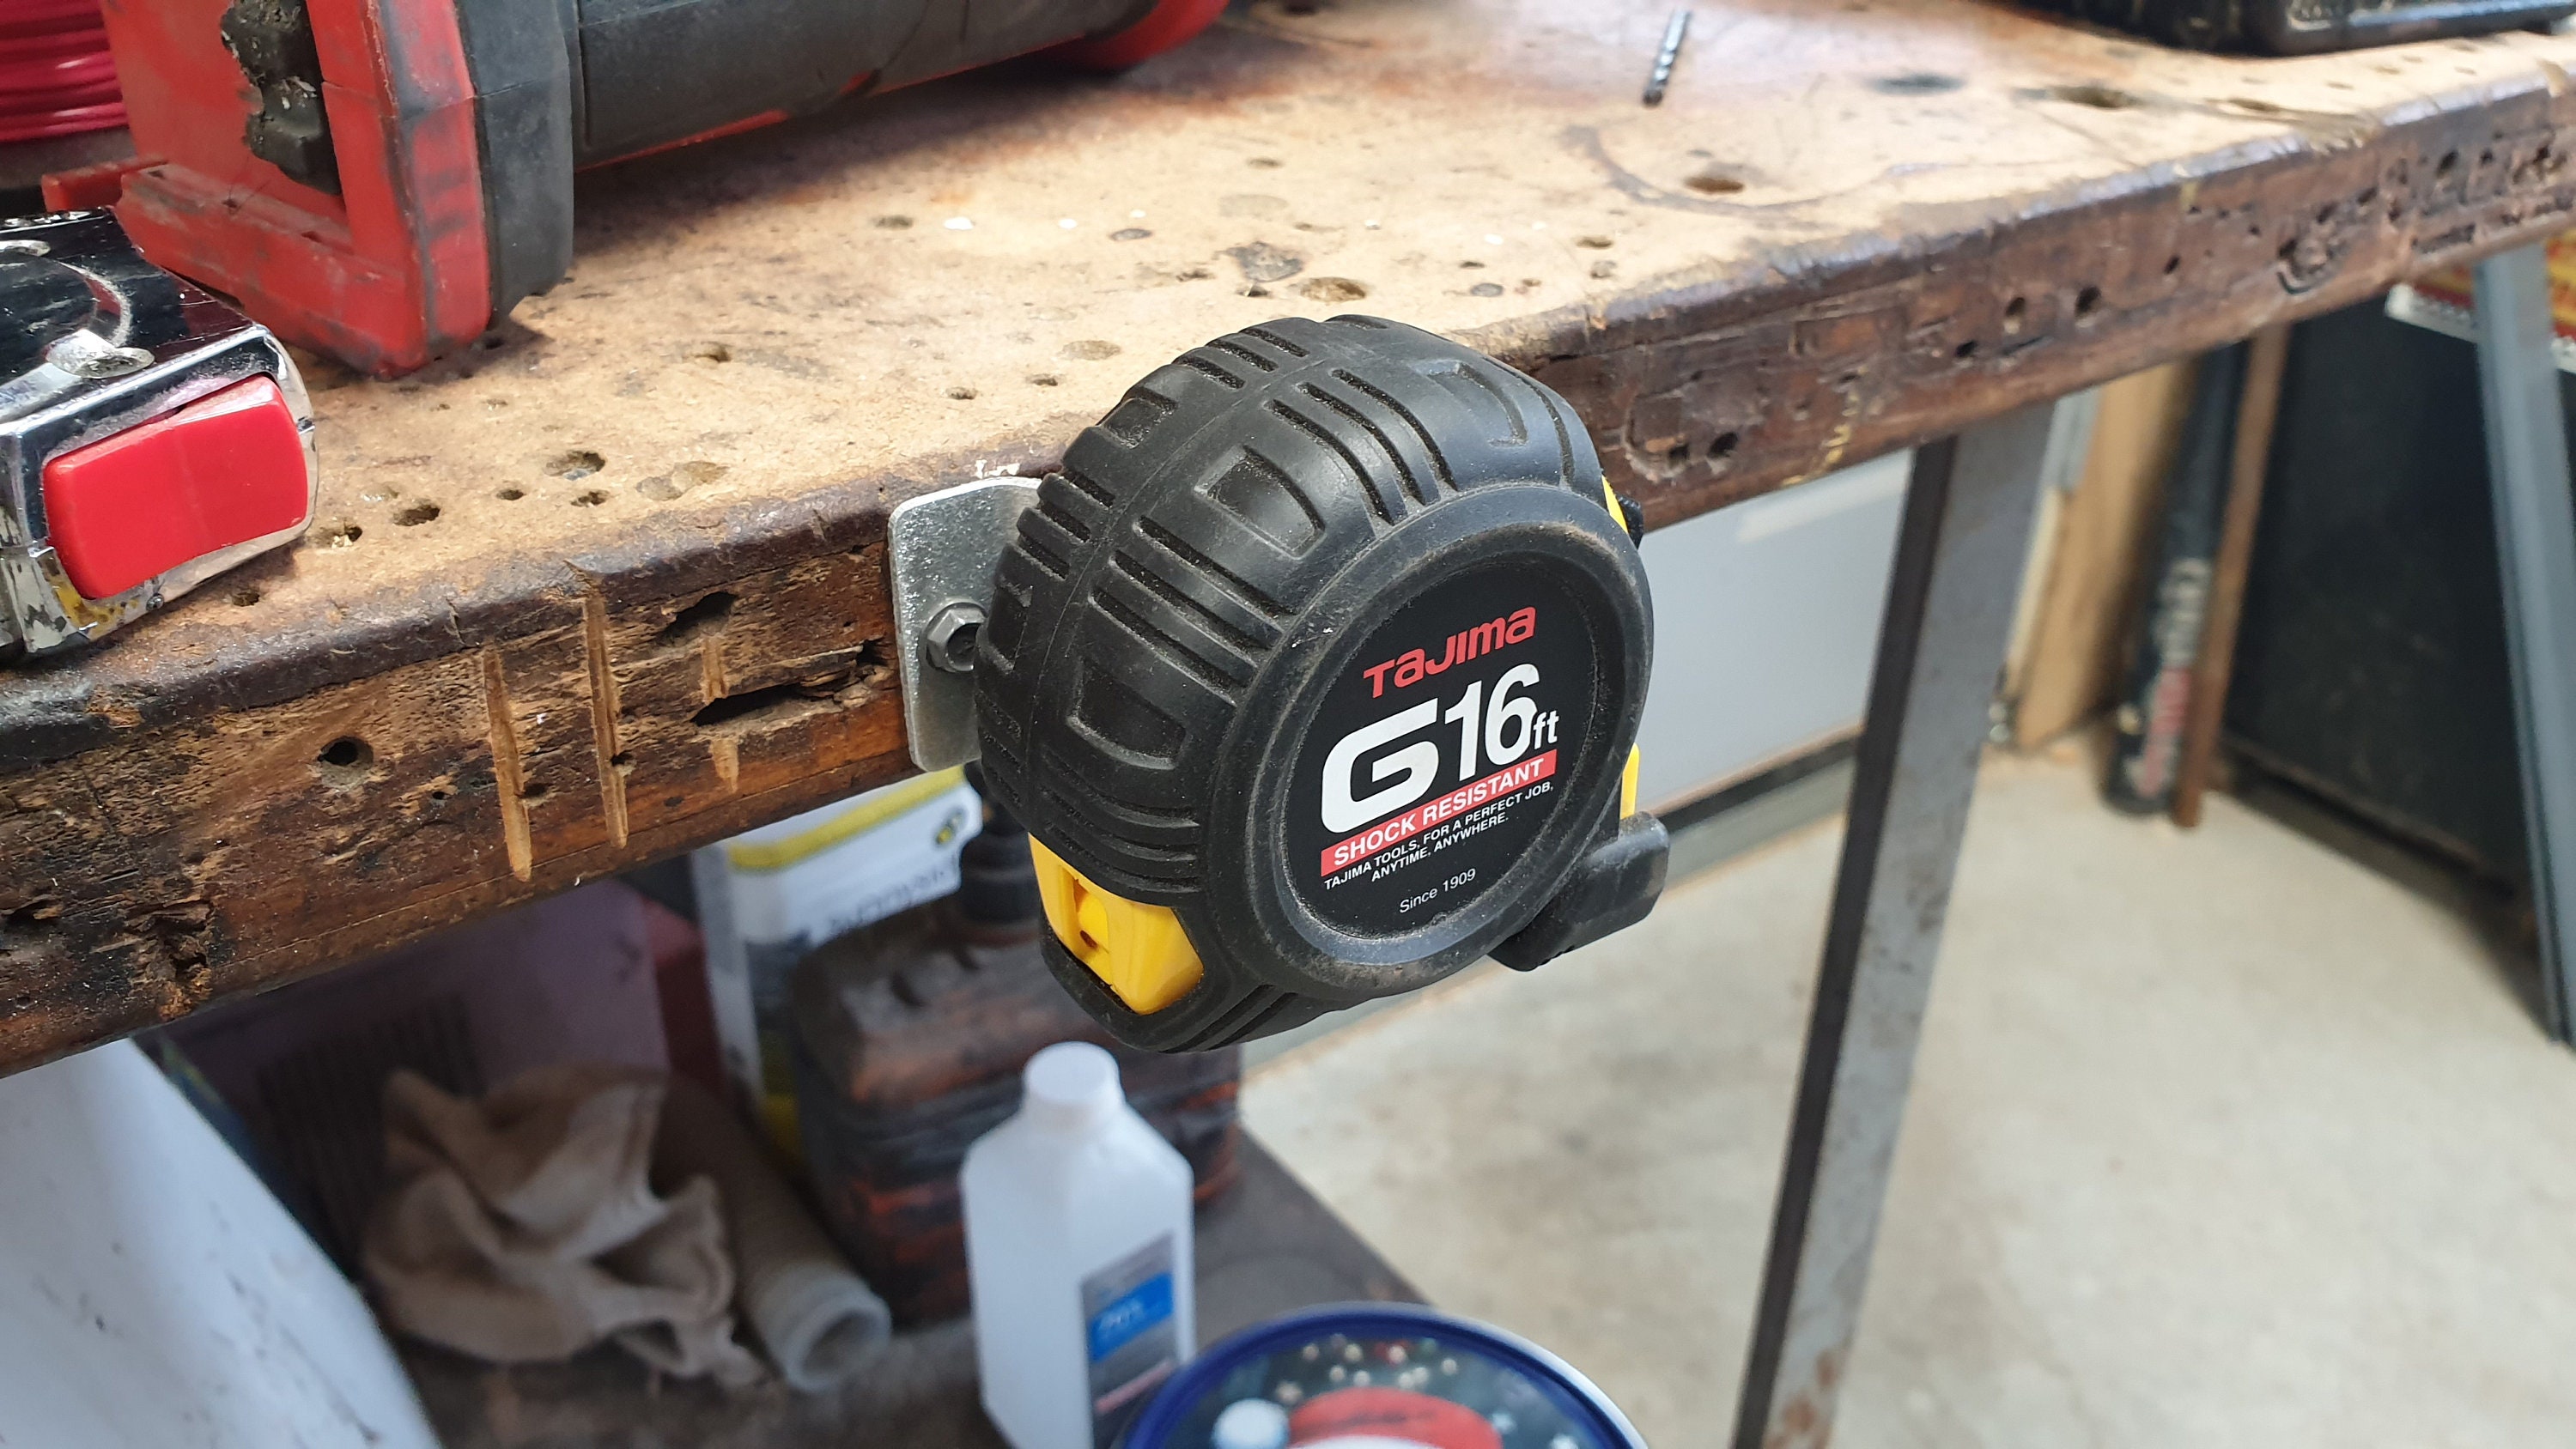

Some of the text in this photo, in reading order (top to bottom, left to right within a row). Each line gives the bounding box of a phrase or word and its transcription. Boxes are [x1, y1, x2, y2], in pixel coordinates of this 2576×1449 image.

[1323, 862, 1372, 890] TAJIMA
[1374, 840, 1421, 867] TOOLS,
[1424, 824, 1450, 846] FOR
[1453, 820, 1462, 832] A
[1465, 792, 1523, 827] PERFECT
[1334, 757, 1545, 866] SHOCK RESISTANT
[1371, 812, 1510, 882] ANYTIME, ANYWHERE.
[1399, 868, 1476, 913] Since 1909
